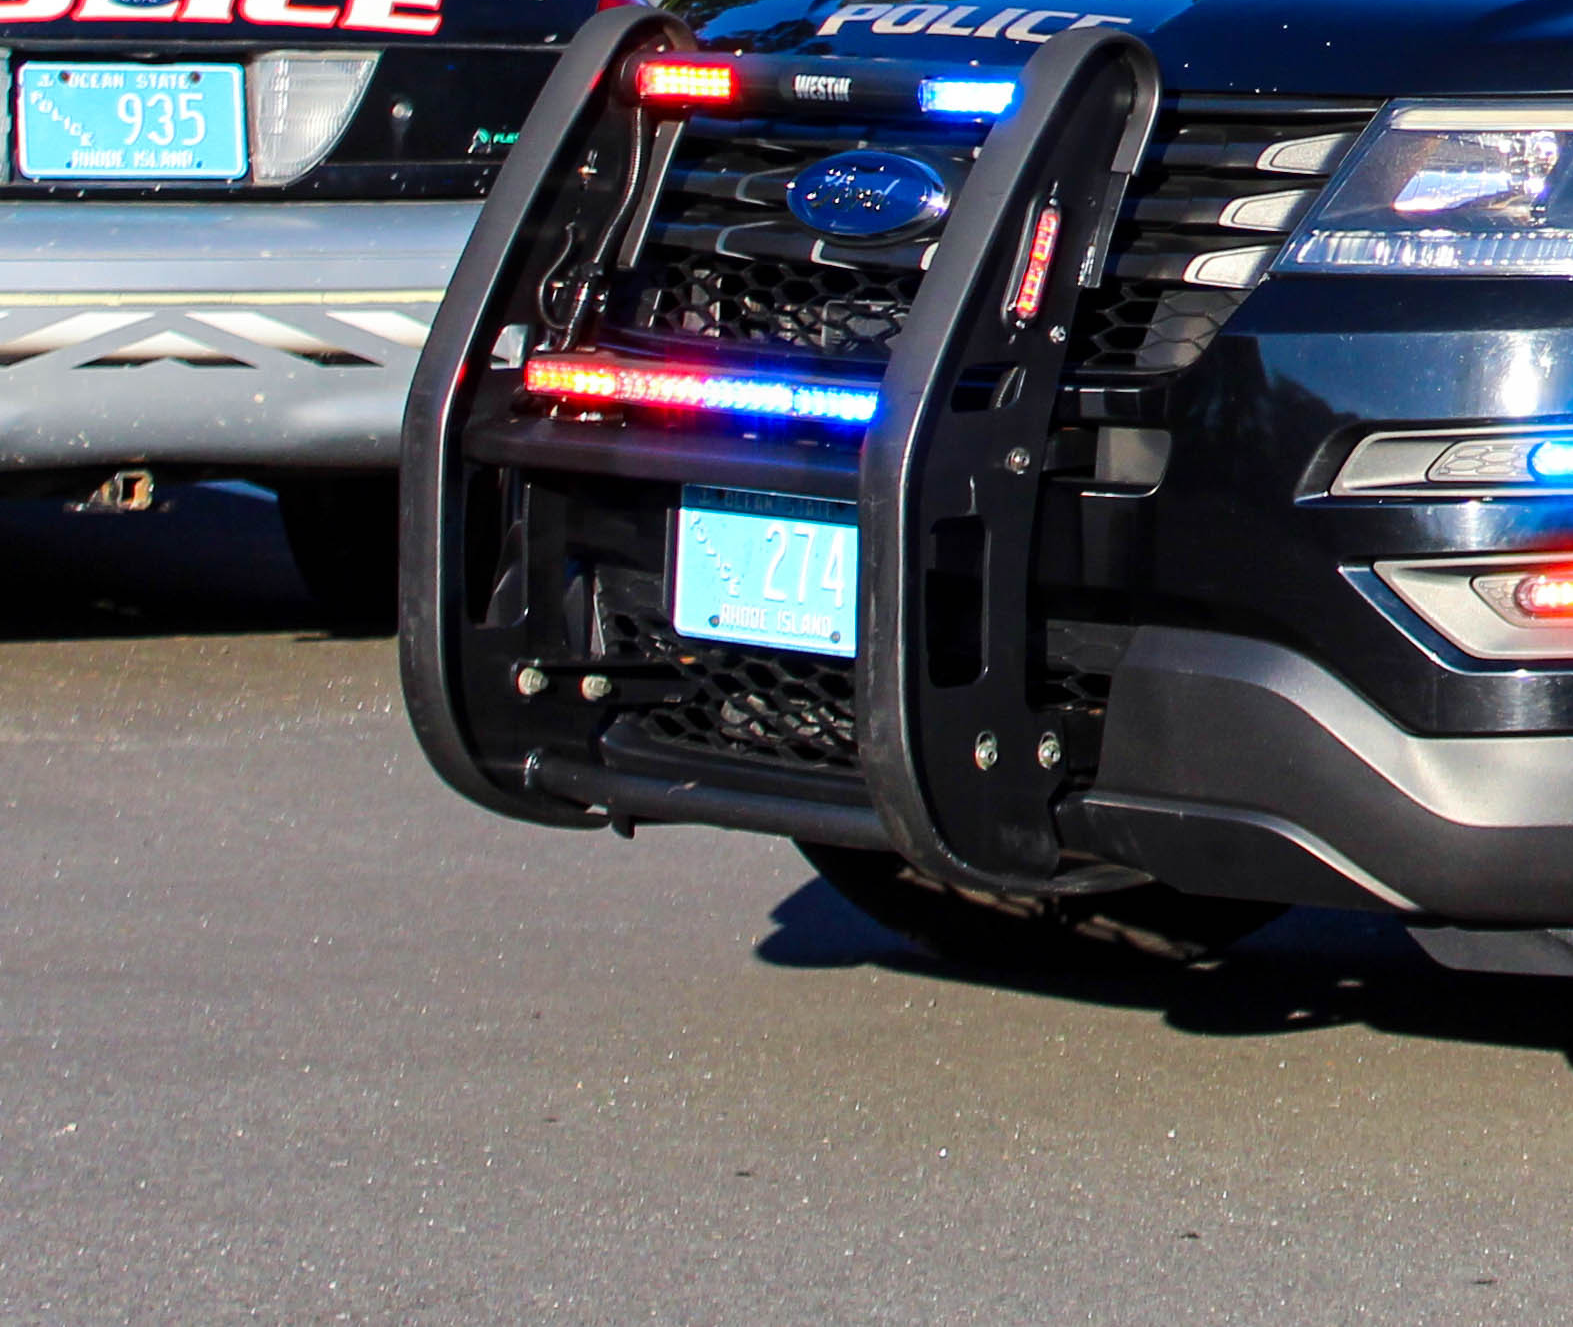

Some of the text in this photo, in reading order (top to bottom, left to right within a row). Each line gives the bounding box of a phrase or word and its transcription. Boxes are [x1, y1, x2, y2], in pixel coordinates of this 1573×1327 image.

[68, 73, 190, 89] OCEAN STATE
[30, 90, 94, 148] POLICE
[117, 92, 206, 147] 935
[133, 150, 194, 168] ISLAND
[763, 523, 845, 609] 274
[720, 603, 833, 640] RHODE ISLAND
